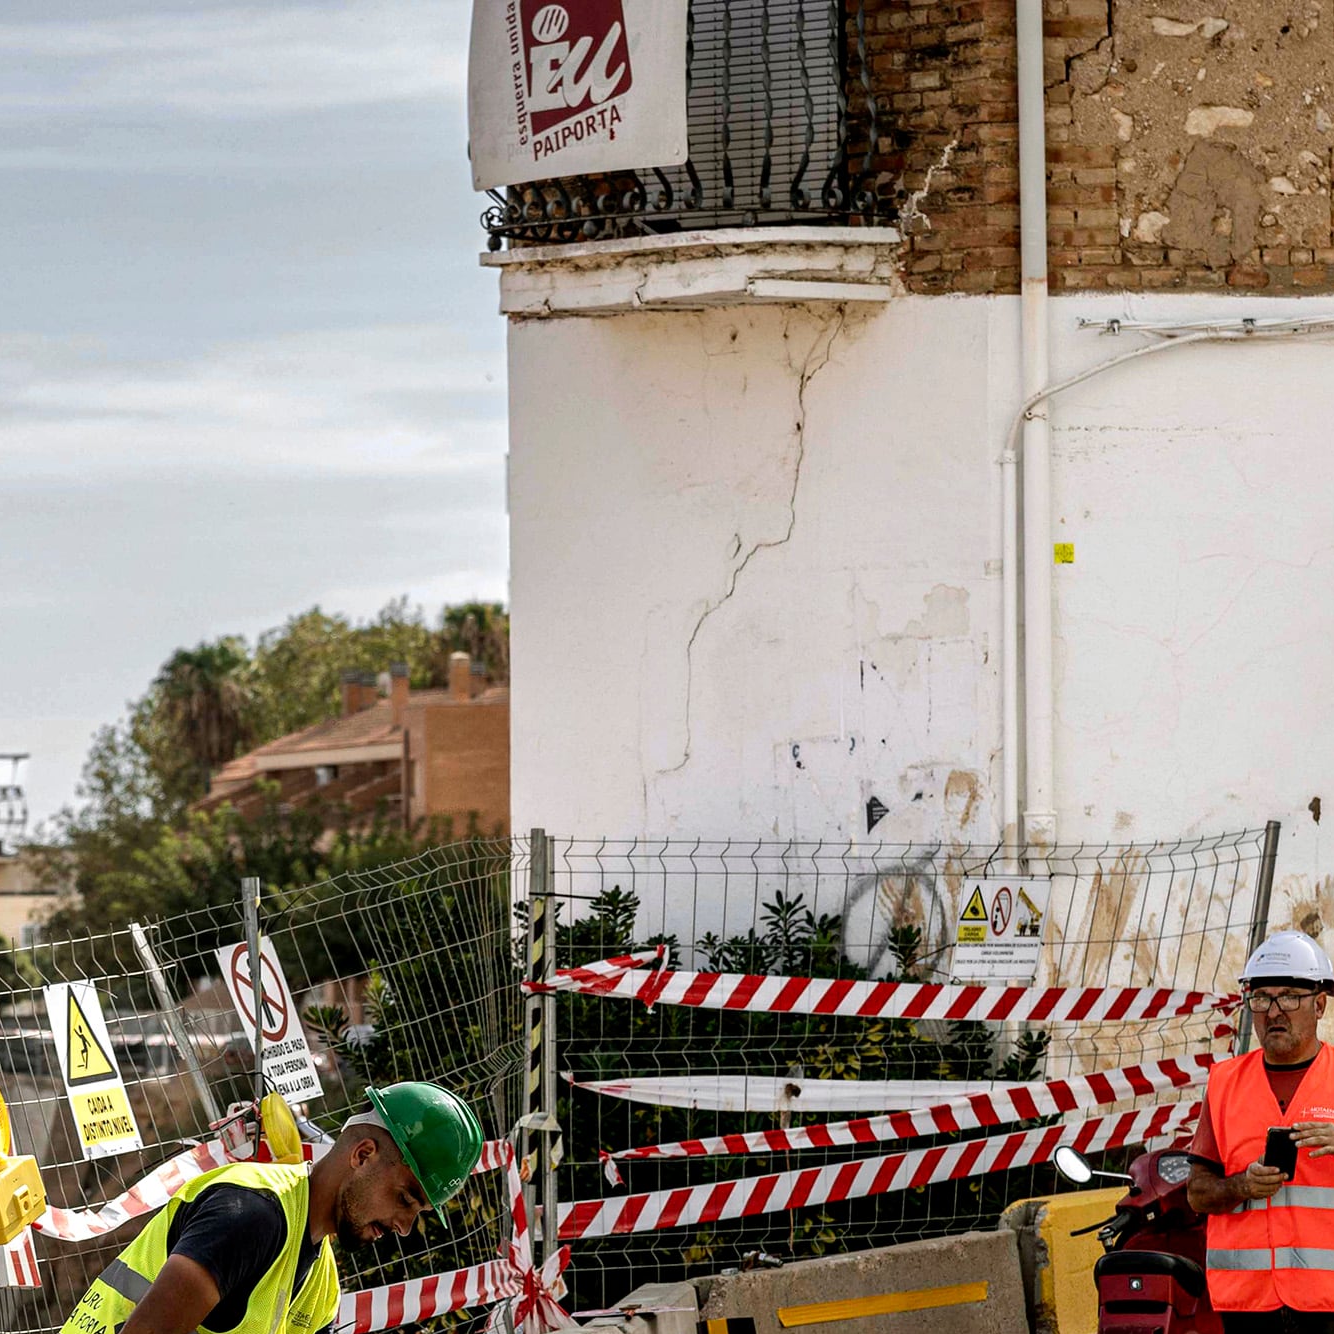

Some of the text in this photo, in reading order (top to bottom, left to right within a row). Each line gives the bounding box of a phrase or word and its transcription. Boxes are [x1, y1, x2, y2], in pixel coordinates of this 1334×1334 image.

[505, 3, 529, 146] esquerra unida
[532, 104, 623, 162] PAIPORTA
[87, 1094, 114, 1116] CAIDA A
[83, 1115, 134, 1141] DISTINTO NIVEL
